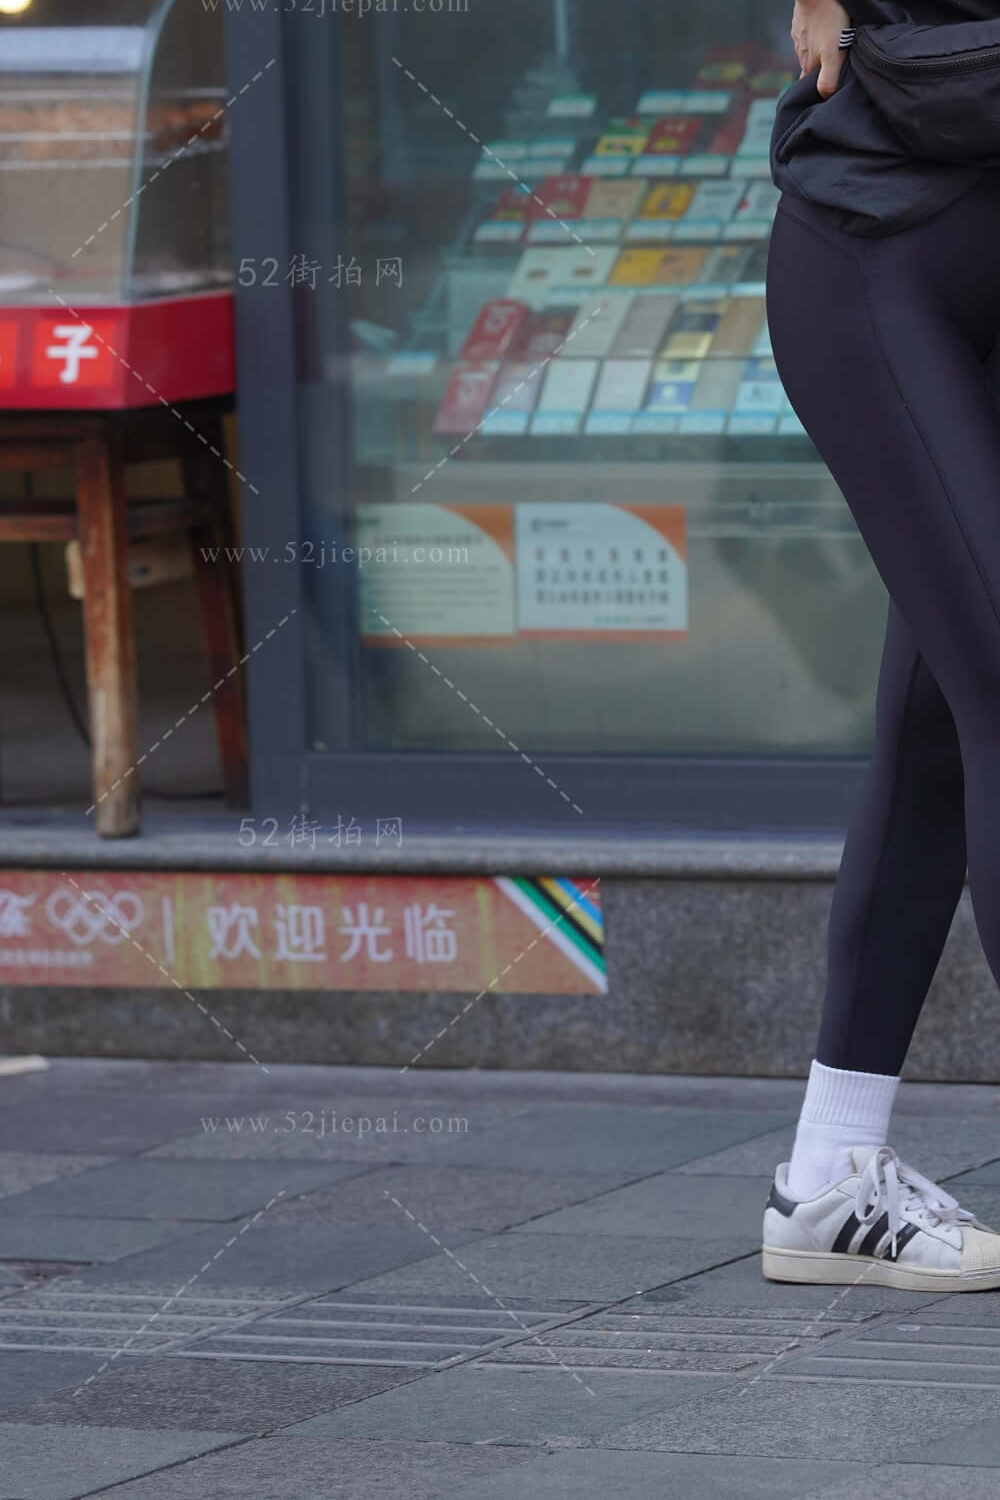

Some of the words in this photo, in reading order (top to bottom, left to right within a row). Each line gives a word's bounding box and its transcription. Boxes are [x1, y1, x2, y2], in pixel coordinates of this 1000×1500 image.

[46, 324, 98, 384] 子
[206, 901, 458, 964] 欢迎光临
